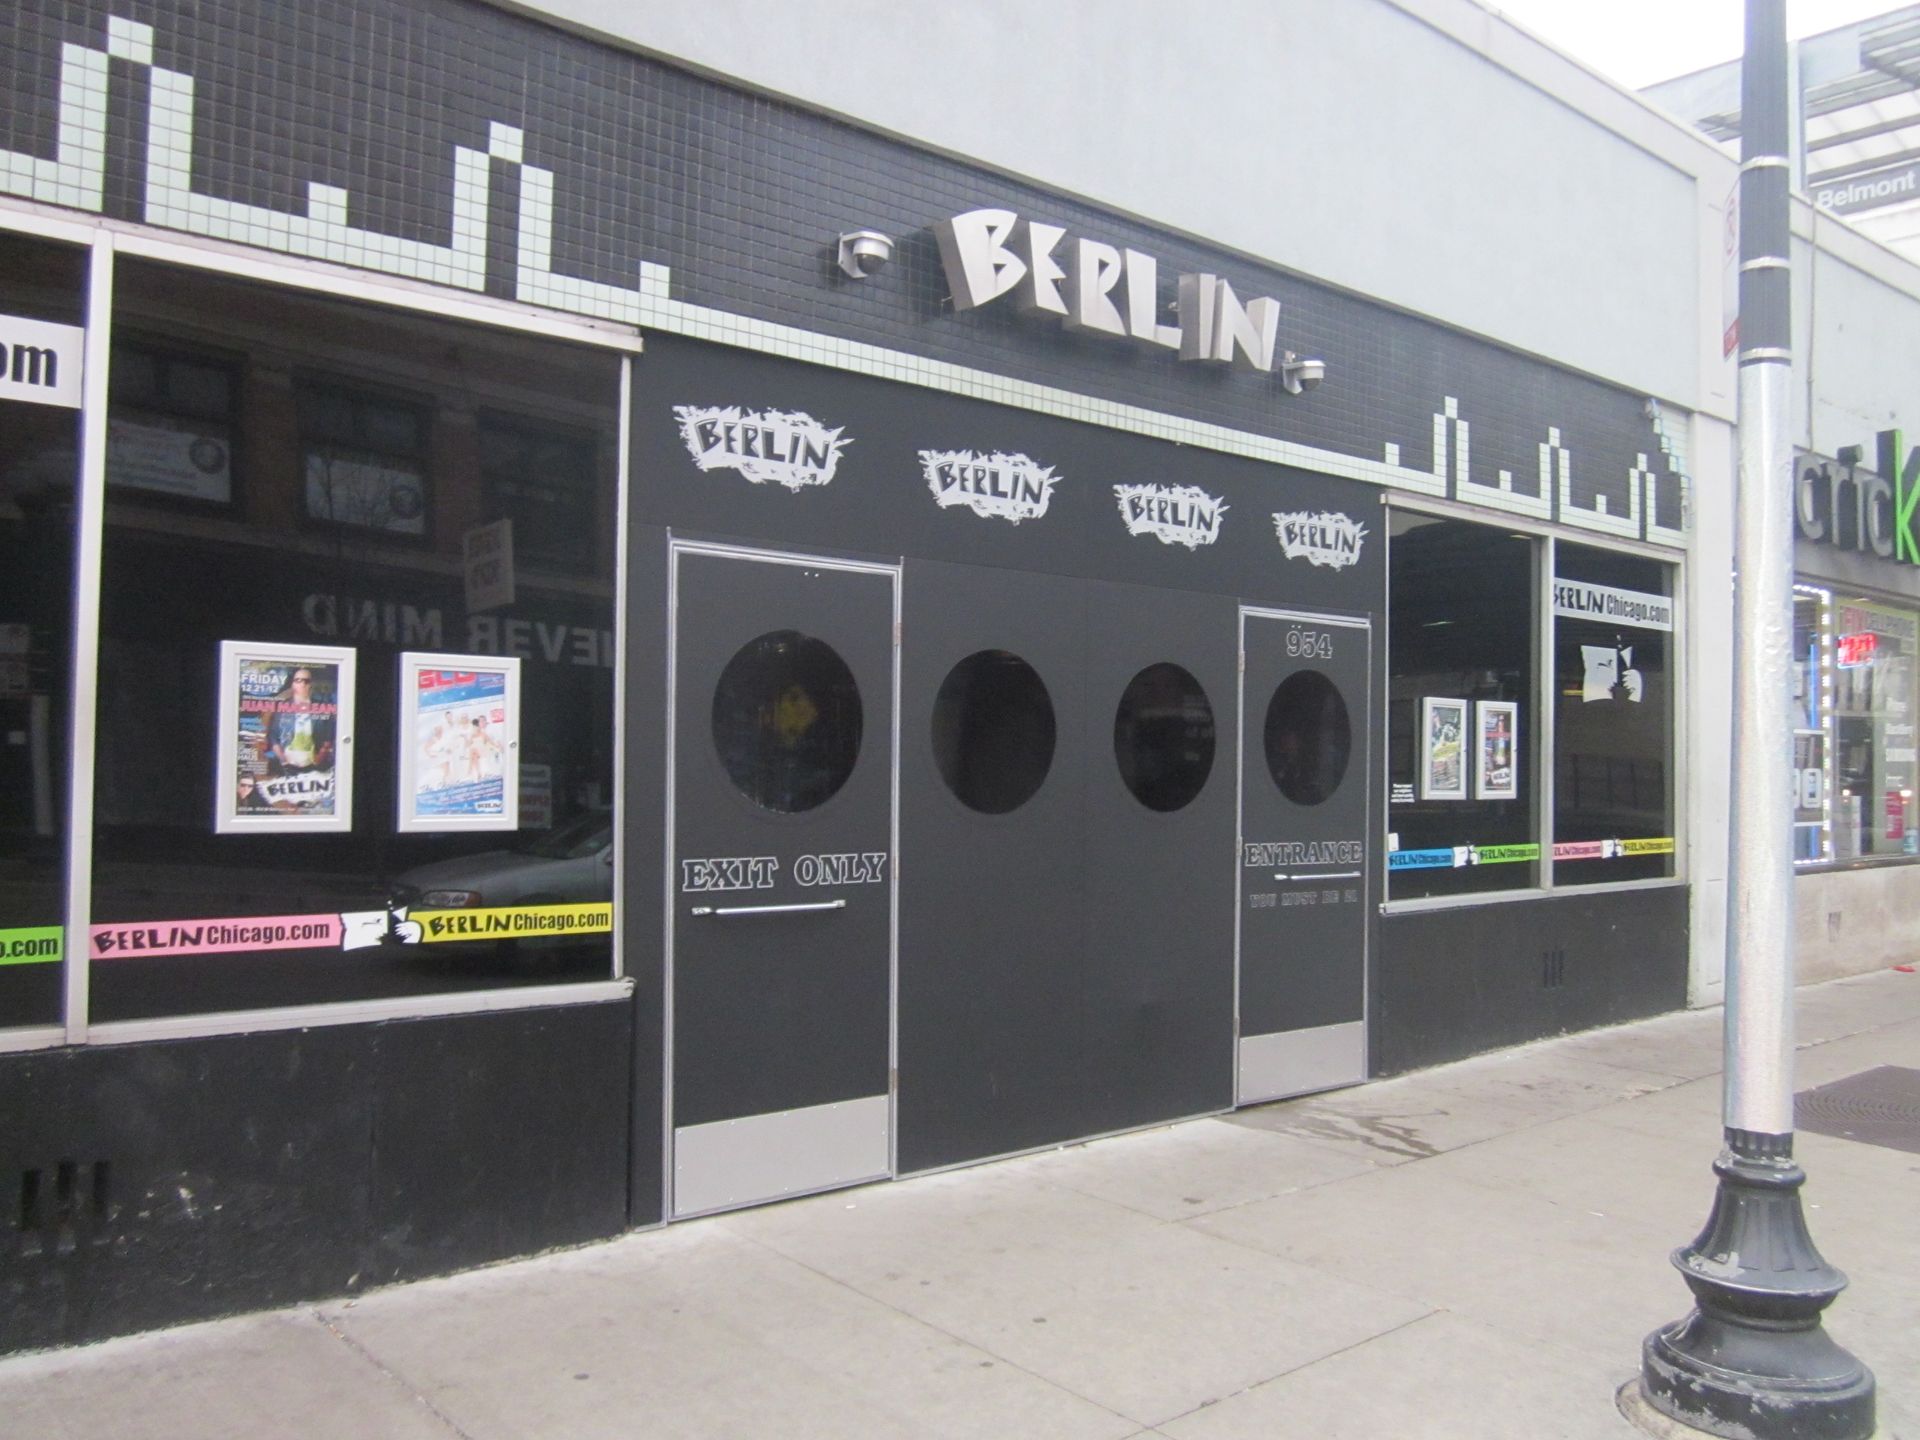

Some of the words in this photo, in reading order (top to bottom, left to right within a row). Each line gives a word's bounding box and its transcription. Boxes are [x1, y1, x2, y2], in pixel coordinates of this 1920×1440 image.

[1817, 170, 1916, 208] Belmont
[938, 208, 1281, 371] BERLIN
[694, 417, 831, 470] BERLIN
[934, 461, 1044, 504] BERLIN
[1127, 494, 1215, 532] BERLIN
[1283, 520, 1356, 554] BERLIN
[1286, 630, 1334, 659] 954
[241, 673, 288, 686] FRIDAY
[240, 699, 276, 712] JUAN
[266, 780, 330, 797] BERLIN
[1244, 841, 1363, 867] ENTRANCE
[682, 856, 779, 892] EXIT
[794, 853, 887, 886] ONLY
